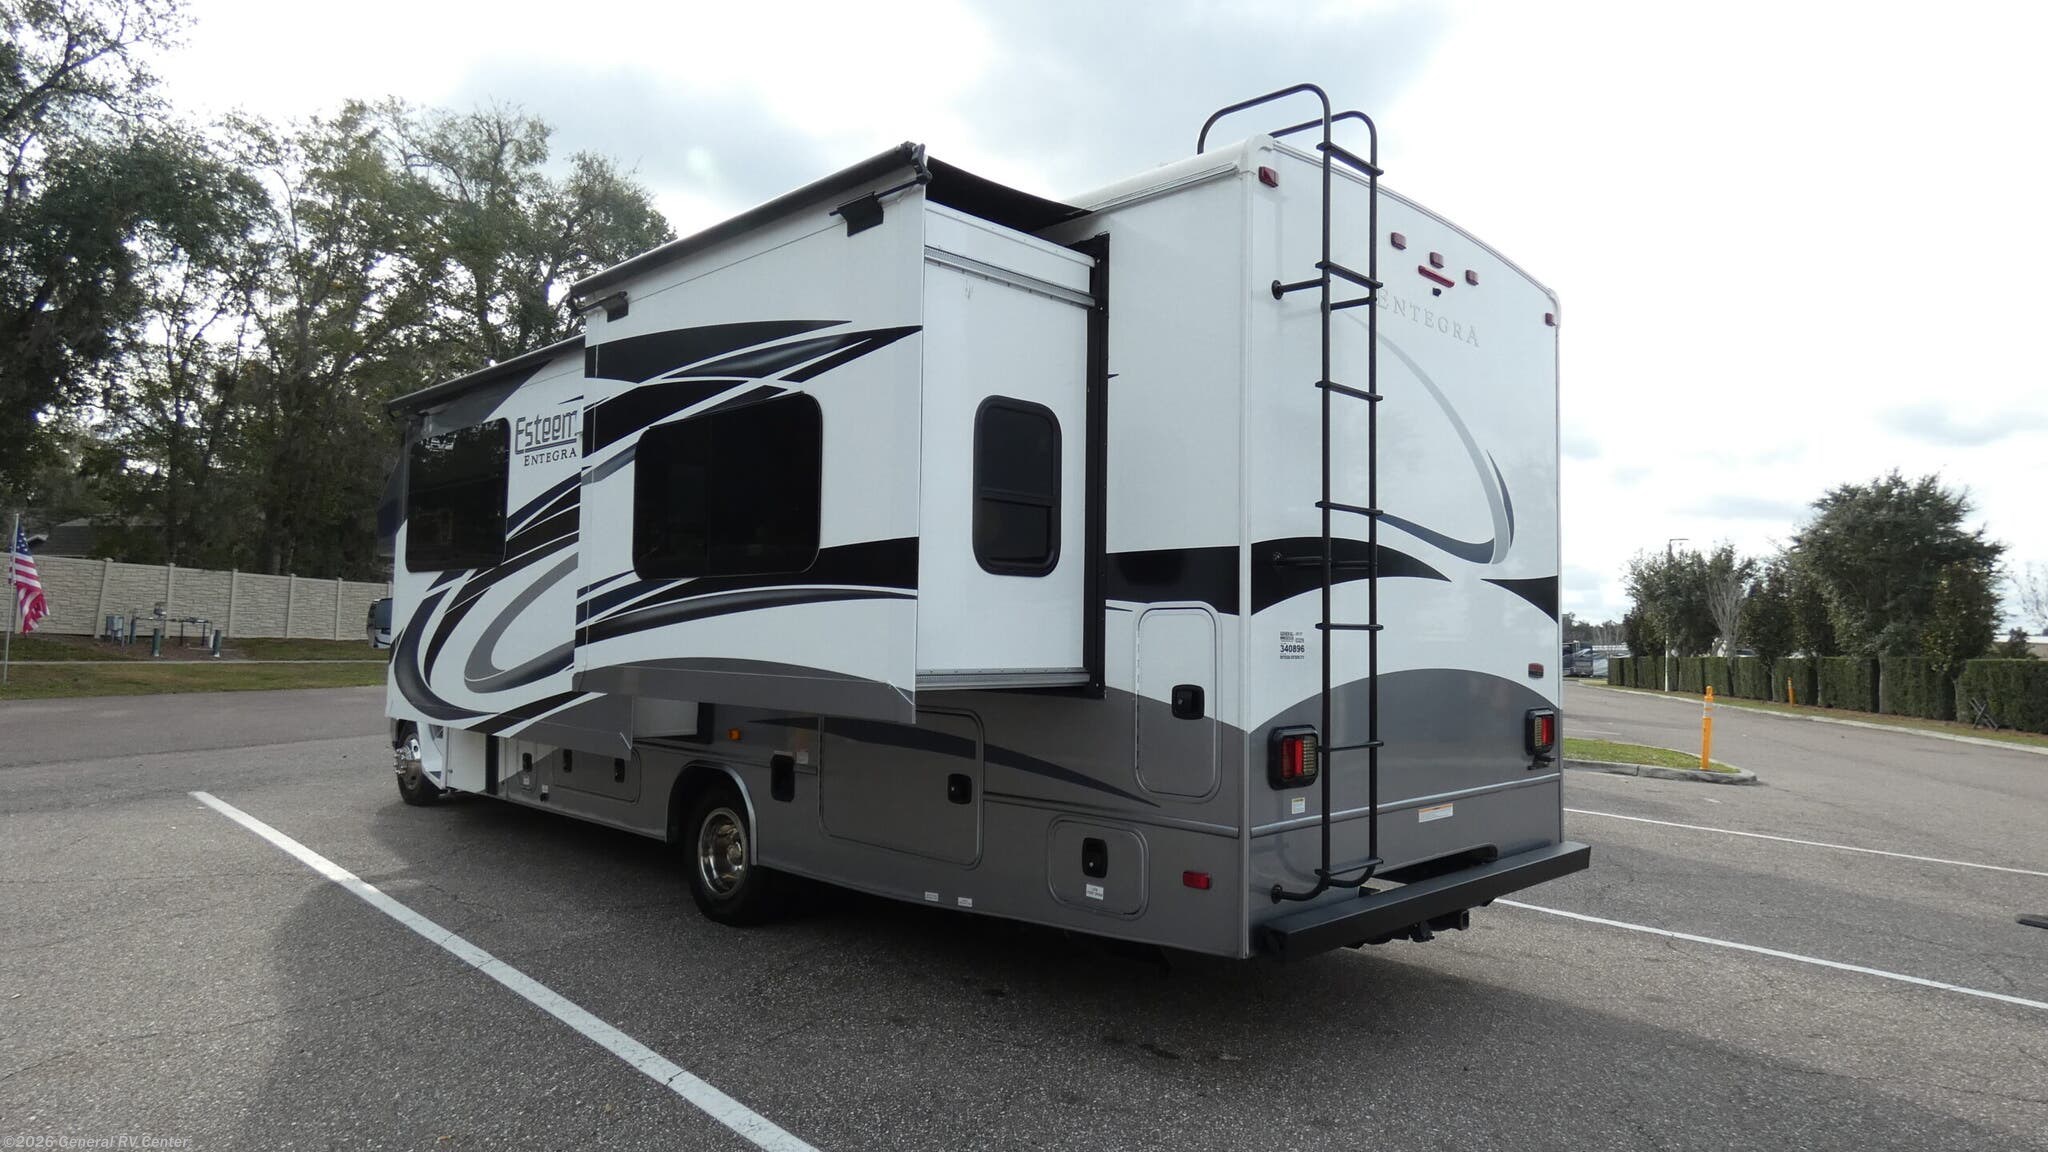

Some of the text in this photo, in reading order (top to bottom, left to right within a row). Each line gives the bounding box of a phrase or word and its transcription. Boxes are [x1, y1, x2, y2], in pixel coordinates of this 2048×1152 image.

[1377, 288, 1480, 347] ENTEGRA
[515, 410, 578, 455] Esteem
[524, 447, 577, 467] ENTEGRA
[1280, 644, 1305, 653] 340896
